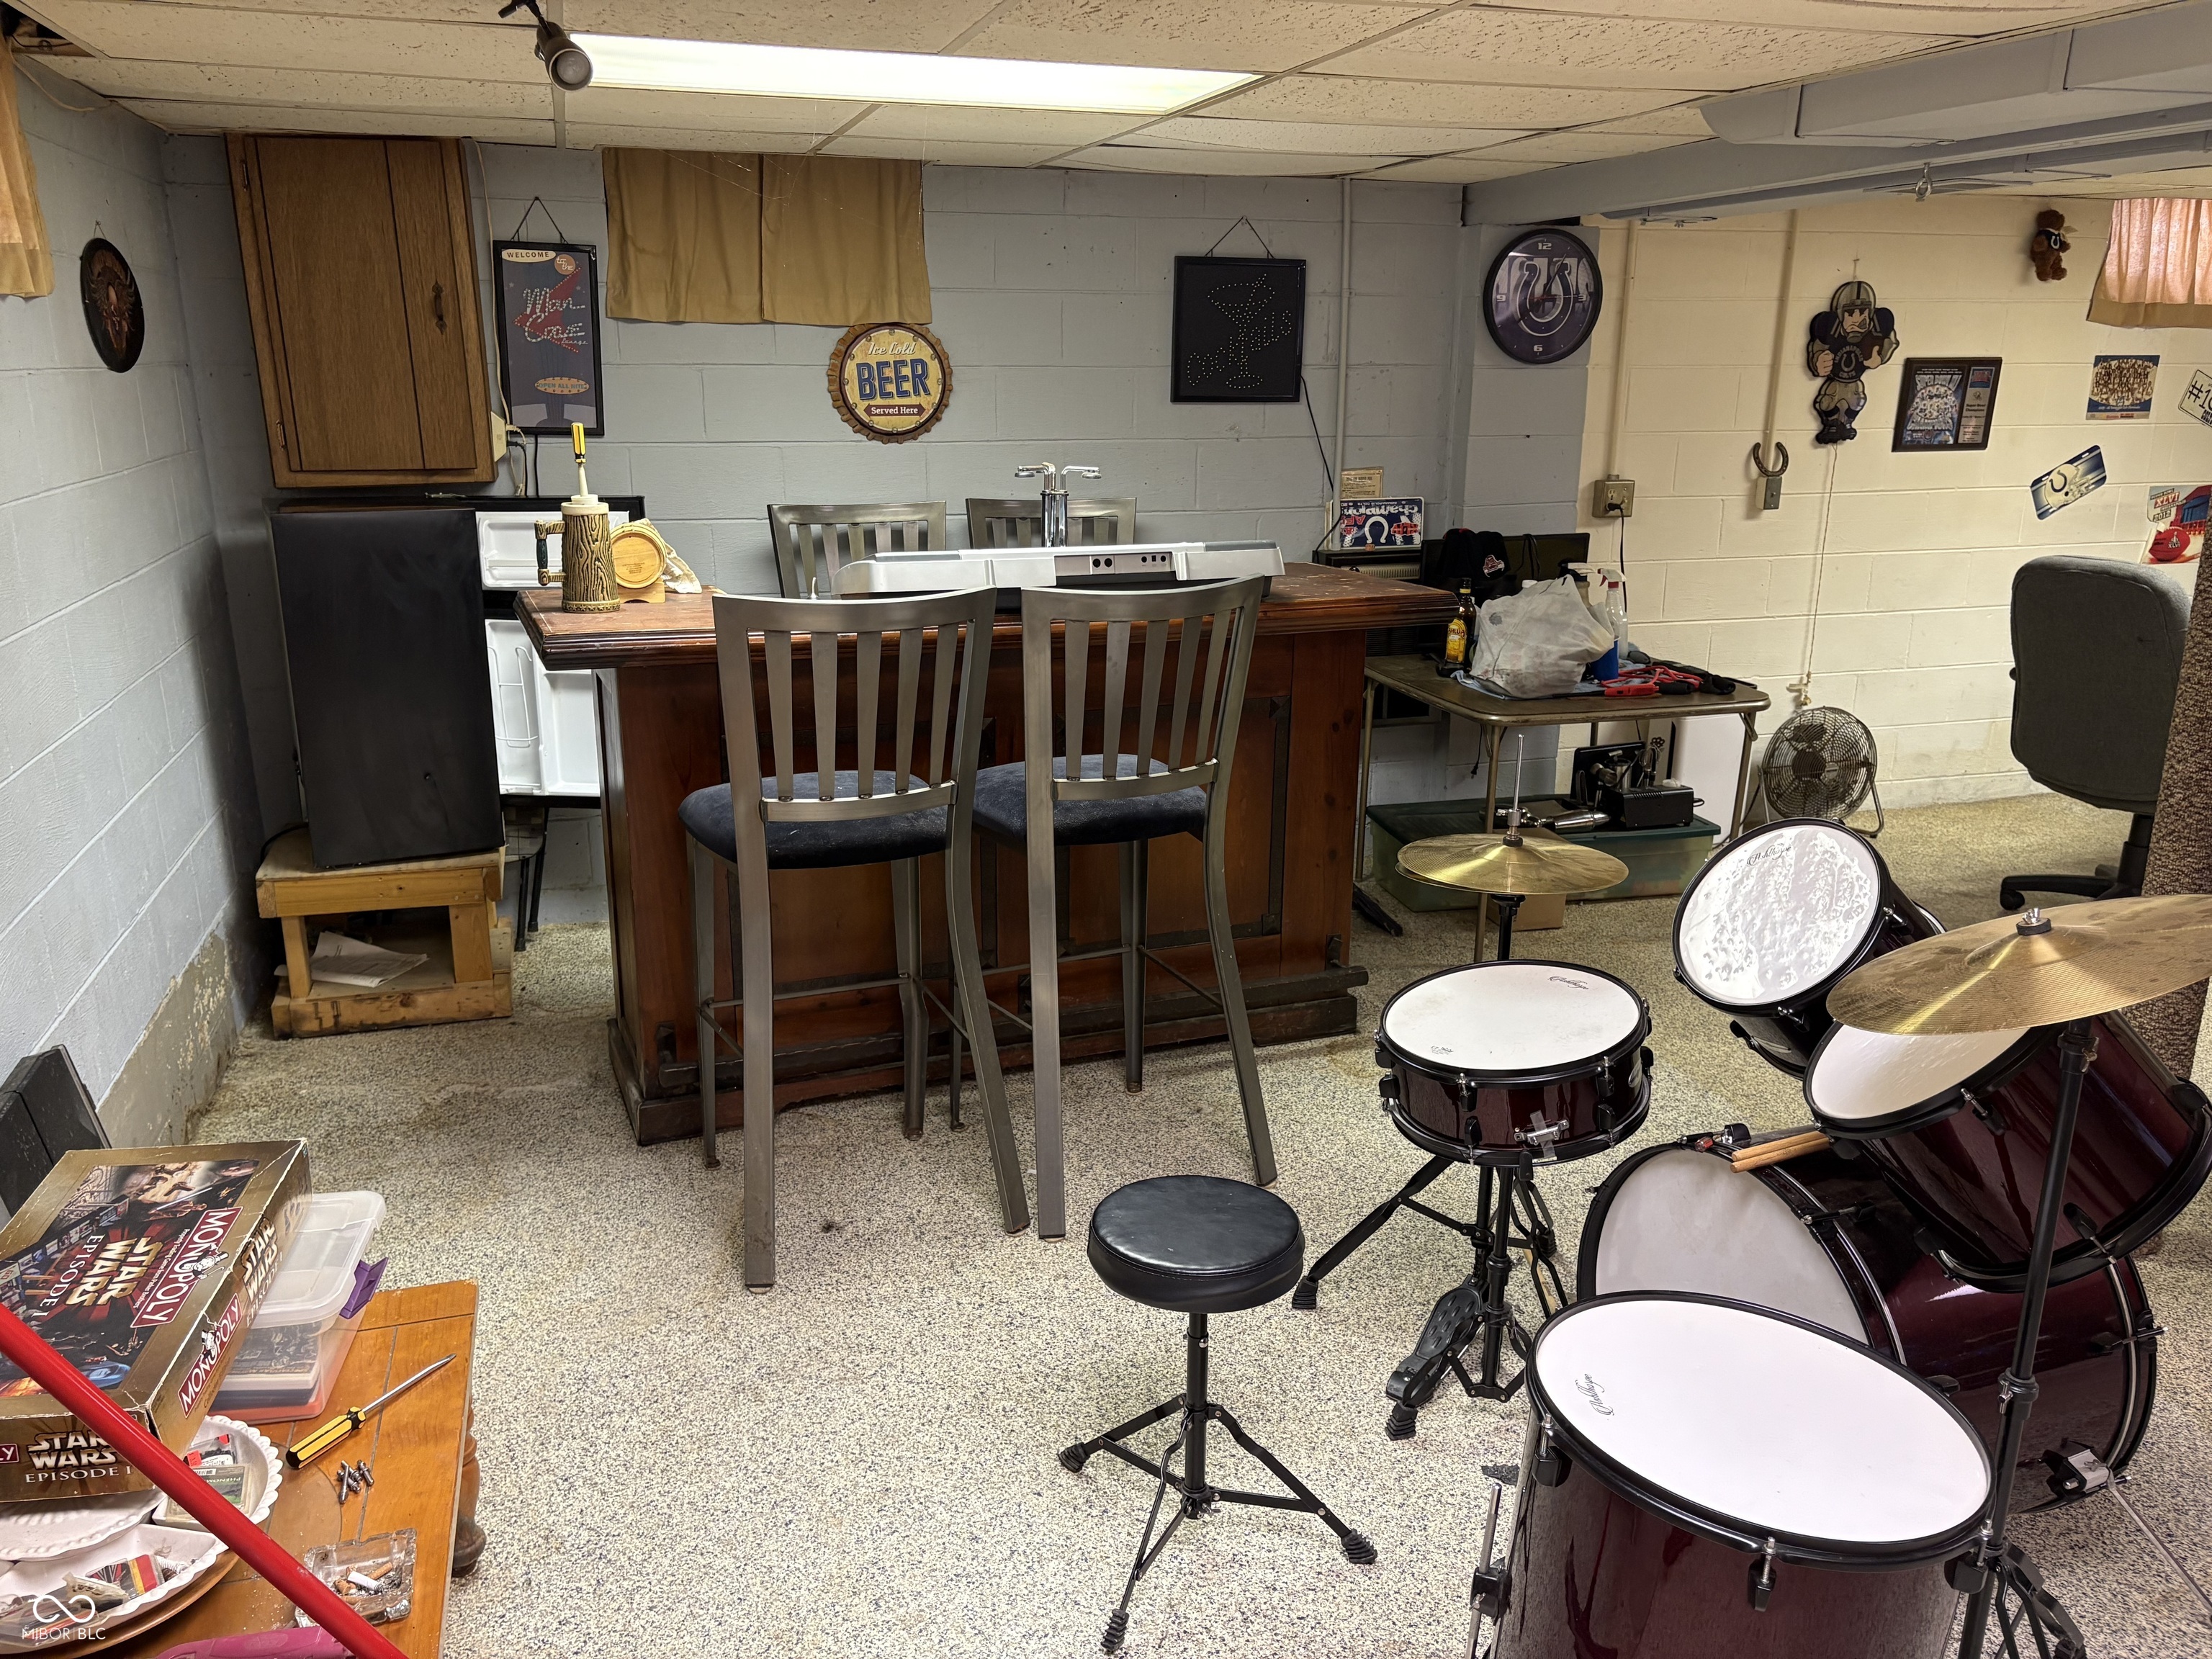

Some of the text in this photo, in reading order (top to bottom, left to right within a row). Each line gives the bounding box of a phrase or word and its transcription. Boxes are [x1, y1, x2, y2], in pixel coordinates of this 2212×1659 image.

[562, 262, 575, 271] the
[868, 342, 917, 356] Ice Cold
[856, 358, 930, 400] BEER
[2187, 379, 2212, 409] #1
[1341, 505, 1419, 516] champion
[2155, 492, 2180, 507] XLVI
[40, 1233, 106, 1307] EPISODE
[96, 1236, 163, 1305] STAR
[142, 1210, 237, 1321] MONOPOLY
[240, 1218, 276, 1283] STAR
[246, 1232, 278, 1302] WARS
[66, 1238, 137, 1306] WARS
[181, 1298, 238, 1413] MONOPOLY
[25, 1465, 132, 1483] EPISODE I
[29, 1447, 117, 1470] WARS
